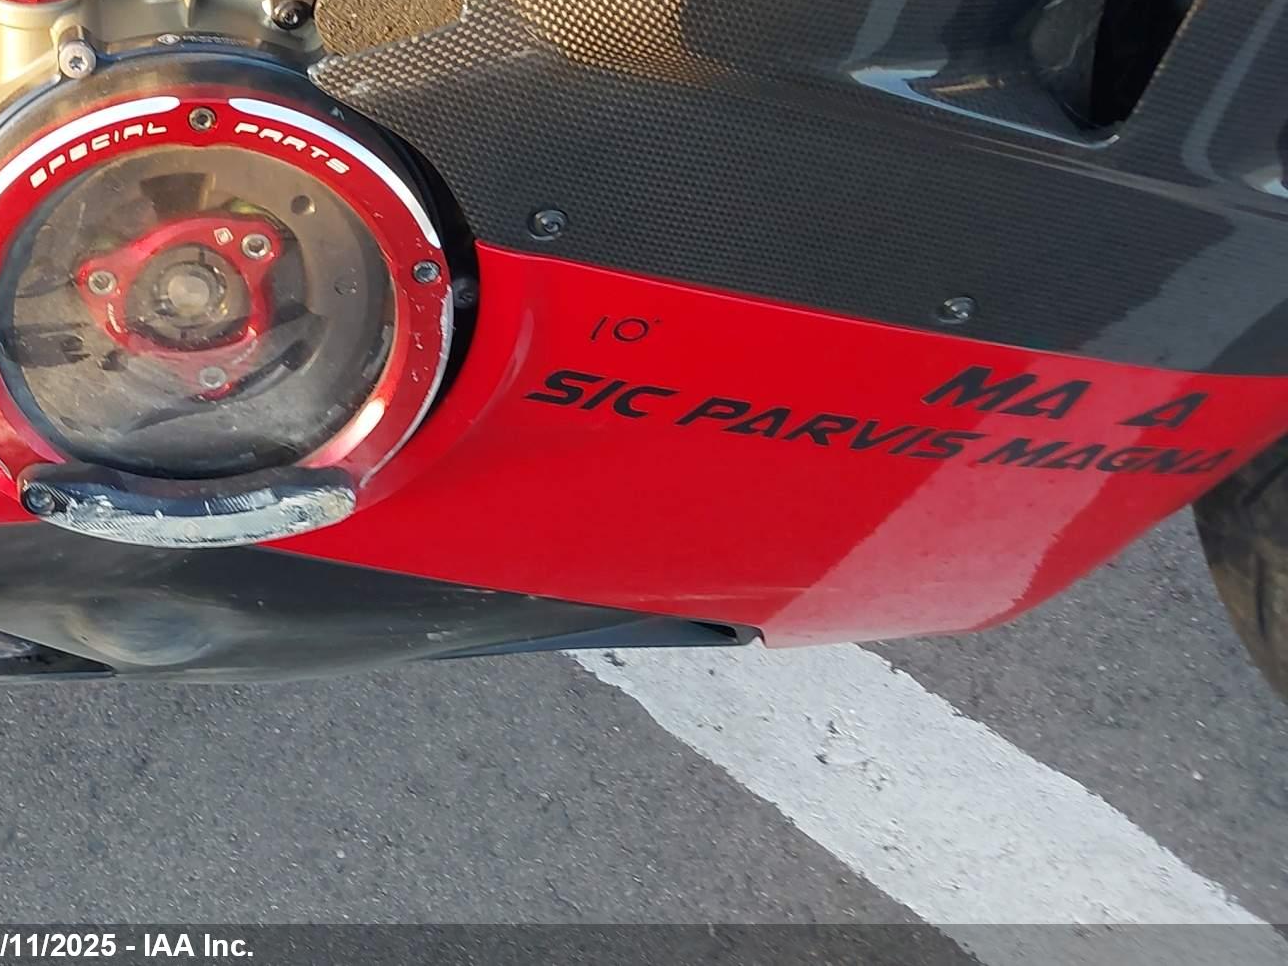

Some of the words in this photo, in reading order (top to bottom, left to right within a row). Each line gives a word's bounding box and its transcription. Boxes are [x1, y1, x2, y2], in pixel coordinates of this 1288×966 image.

[28, 121, 168, 189] SPECIAL
[234, 121, 352, 175] PARTS
[524, 369, 680, 419] SIC
[674, 396, 986, 460] PARVIS
[974, 437, 1235, 475] MAGNA
